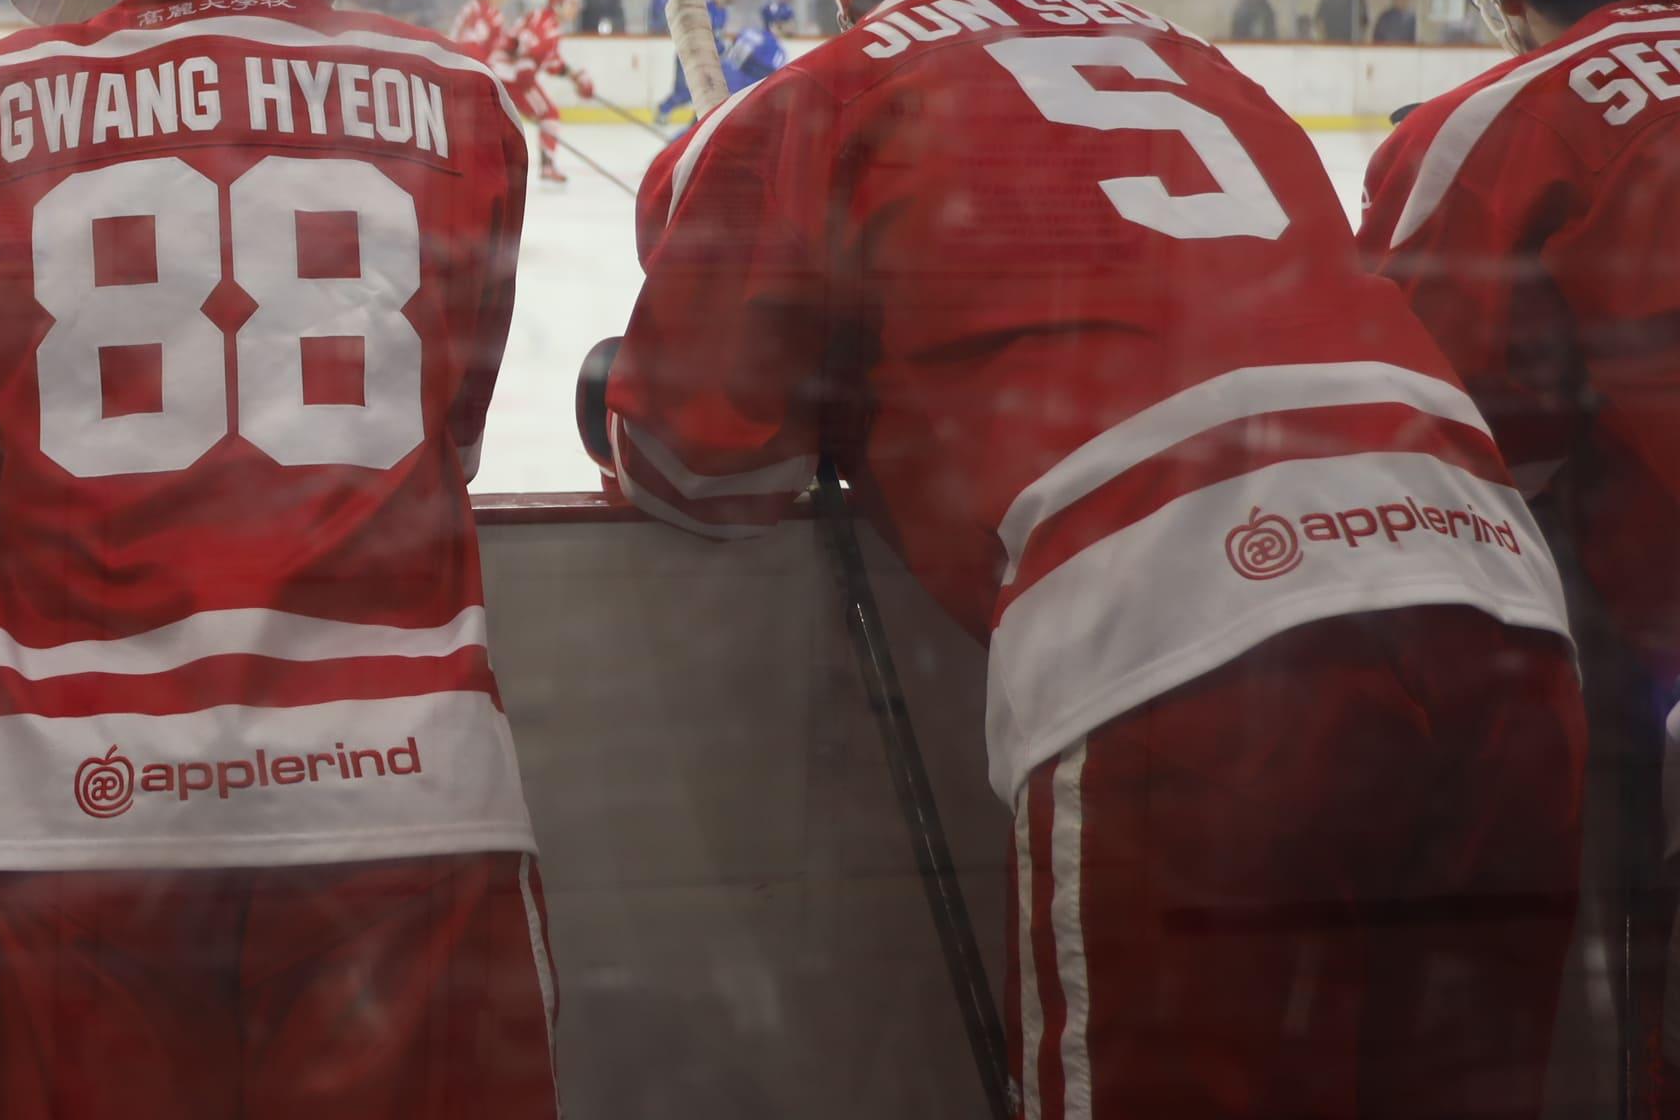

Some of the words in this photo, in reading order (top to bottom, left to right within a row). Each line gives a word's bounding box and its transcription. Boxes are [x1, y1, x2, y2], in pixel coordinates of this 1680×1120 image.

[0, 55, 222, 163] GWANG
[245, 56, 450, 159] HYEON
[983, 34, 1292, 240] 5
[31, 154, 426, 479] 88
[1300, 496, 1522, 555] applerind
[141, 737, 423, 801] applerind
